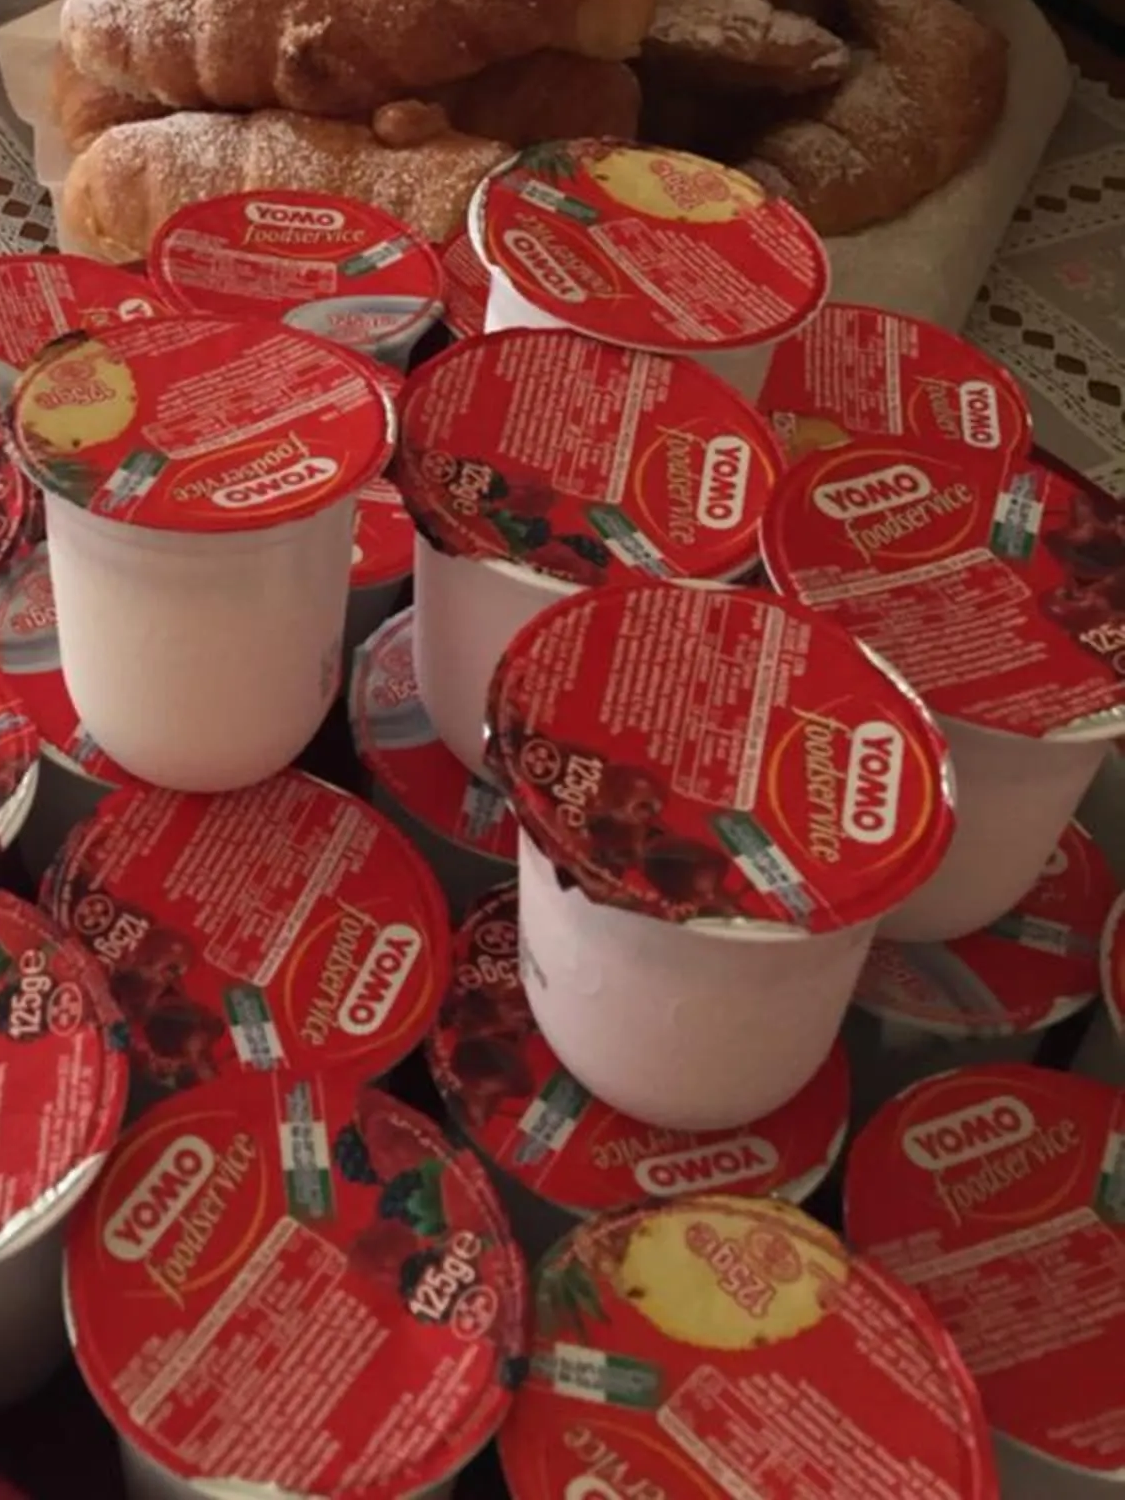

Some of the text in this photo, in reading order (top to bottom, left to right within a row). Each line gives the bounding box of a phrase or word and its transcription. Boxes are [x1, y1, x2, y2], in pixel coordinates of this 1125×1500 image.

[243, 224, 367, 245] foodservice
[254, 203, 336, 228] YOMO
[966, 387, 993, 443] YOMO
[172, 431, 311, 502] foodservice
[223, 462, 331, 503] YOMO
[709, 443, 743, 521] YOMO
[824, 471, 919, 514] YOMO
[844, 482, 973, 565] foodservice
[791, 705, 852, 864] foodservice
[852, 734, 893, 834] YOMO
[299, 897, 380, 1046] foodservice
[347, 935, 419, 1026] YOMO
[647, 1144, 767, 1188] YOMO
[911, 1104, 1023, 1160] YOMO
[112, 1147, 203, 1252] YOMO
[934, 1116, 1080, 1228] foodservice
[144, 1131, 259, 1311] foodservice
